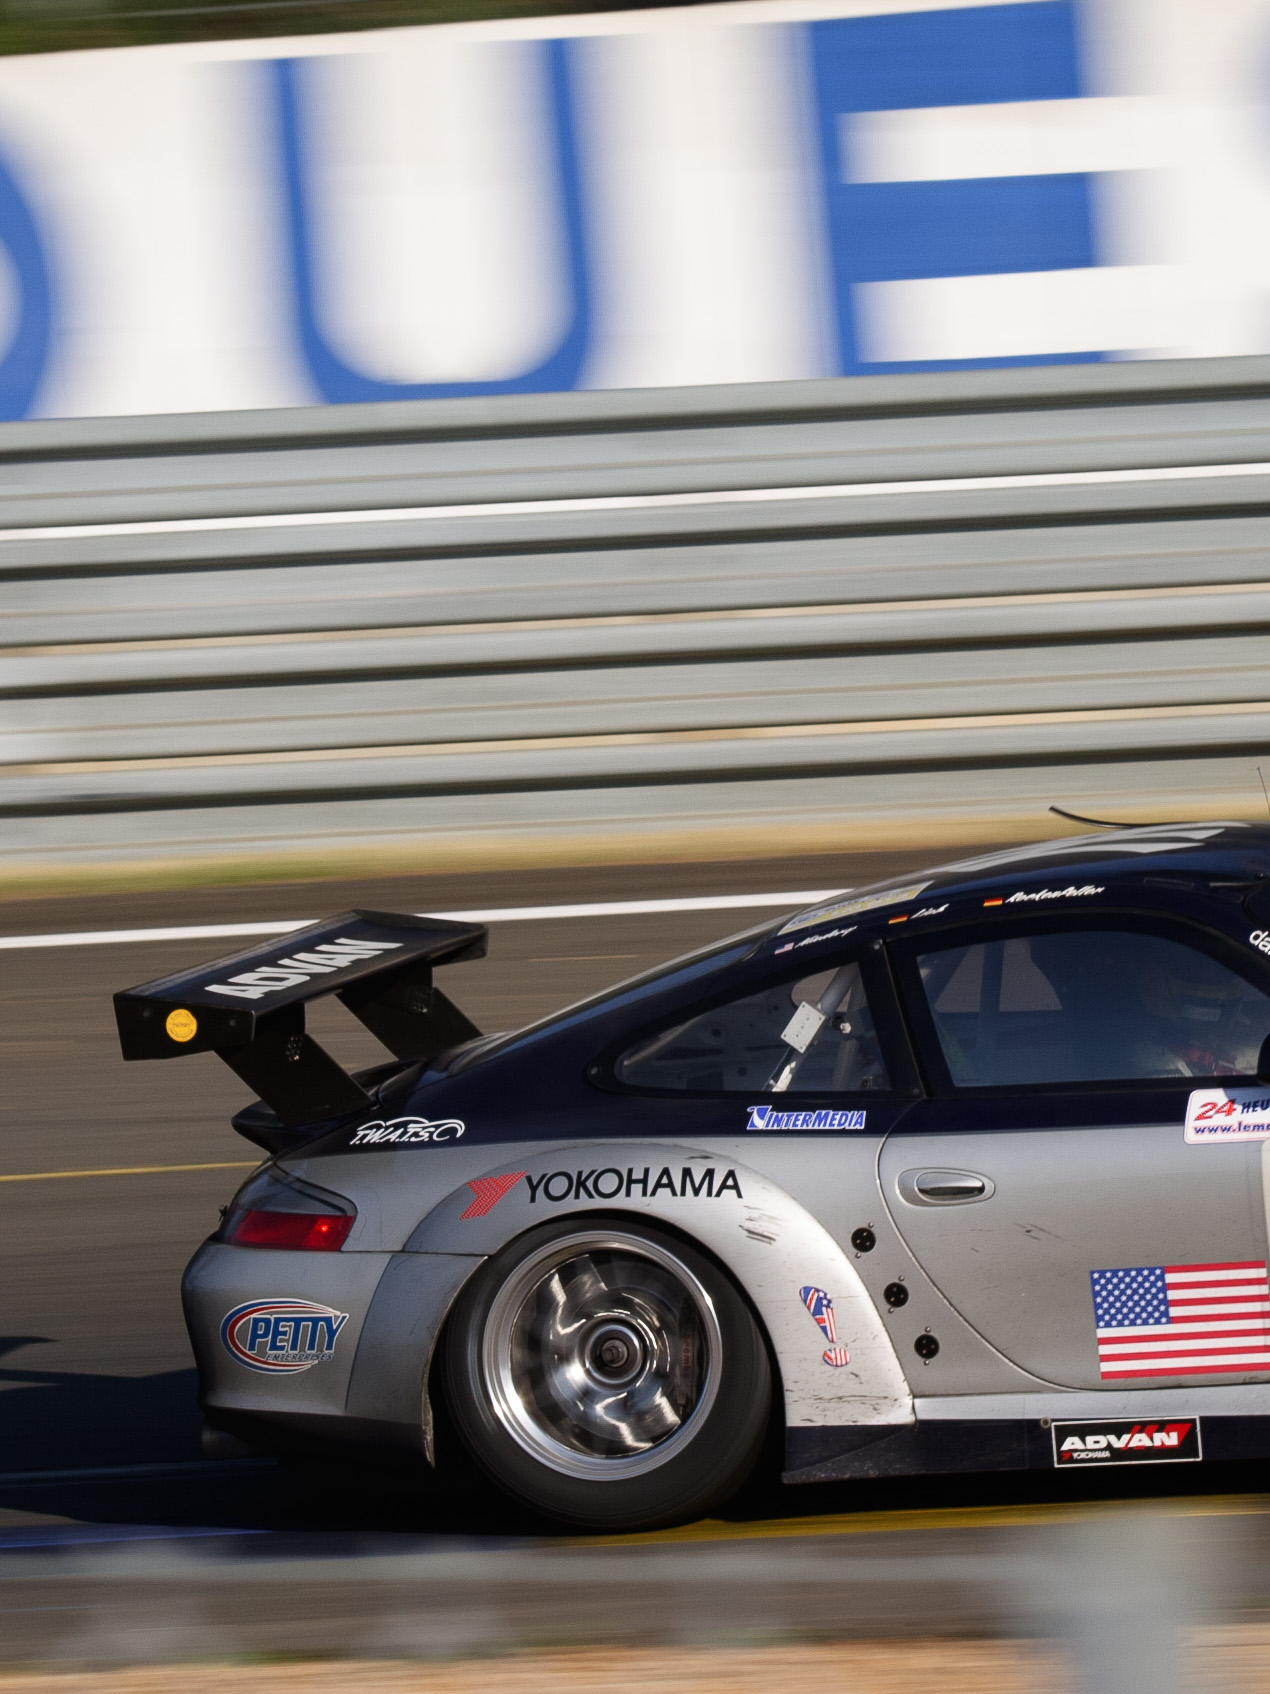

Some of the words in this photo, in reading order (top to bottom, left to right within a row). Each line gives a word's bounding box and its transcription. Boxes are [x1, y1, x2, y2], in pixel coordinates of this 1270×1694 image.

[205, 937, 405, 1000] ADVAN
[1194, 1099, 1237, 1121] 24
[526, 1167, 743, 1203] YOKOHAMA
[247, 1314, 349, 1353] PETTY
[1060, 1431, 1178, 1450] ADVAN
